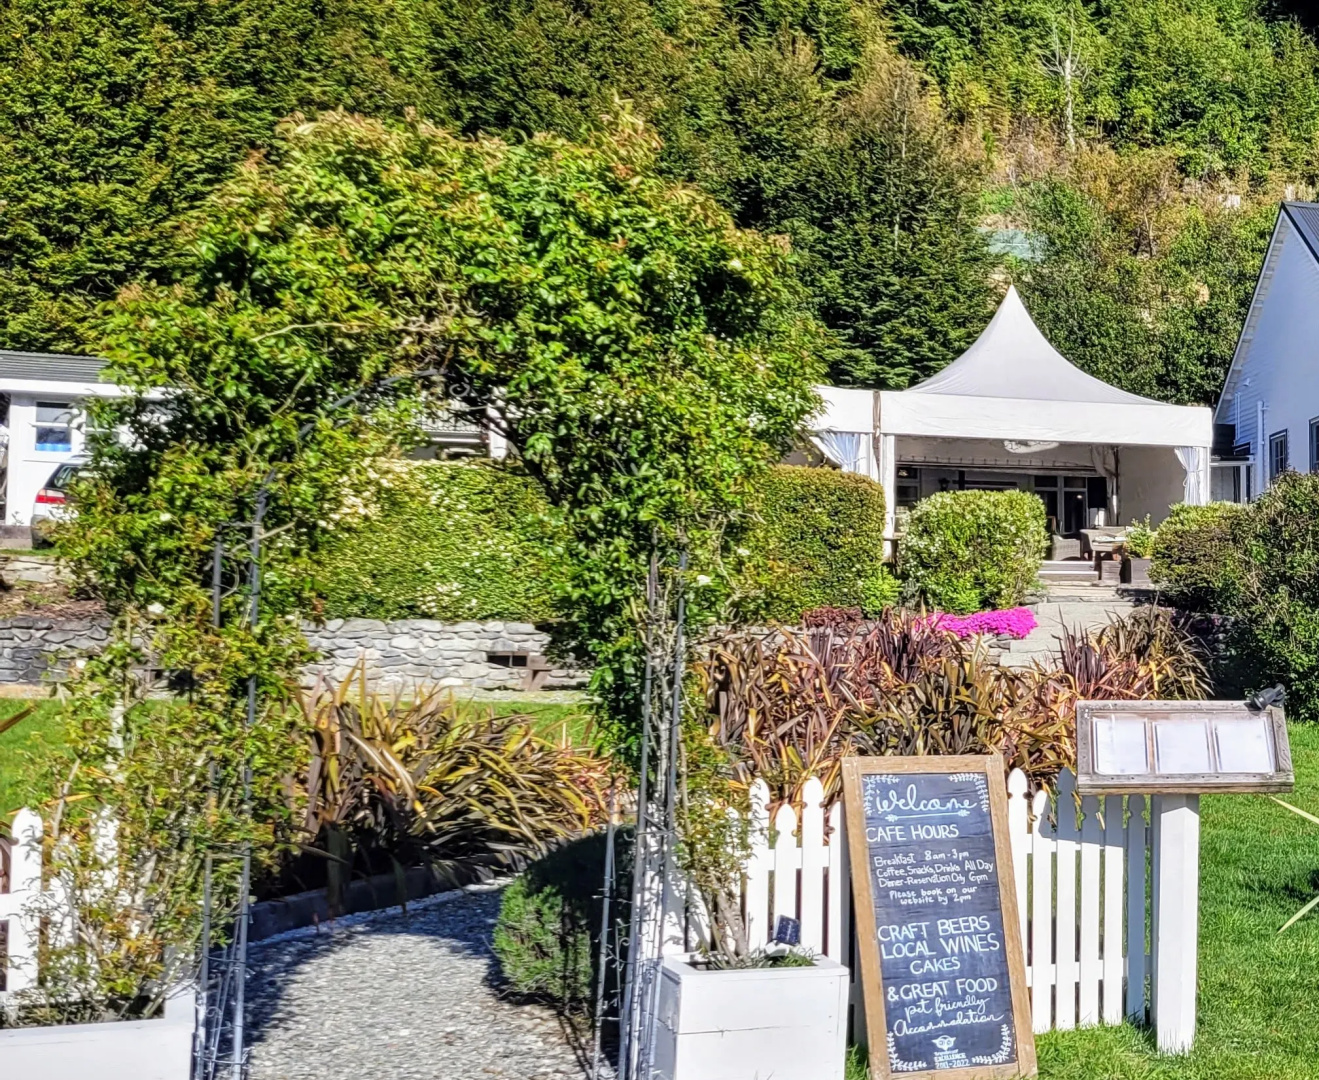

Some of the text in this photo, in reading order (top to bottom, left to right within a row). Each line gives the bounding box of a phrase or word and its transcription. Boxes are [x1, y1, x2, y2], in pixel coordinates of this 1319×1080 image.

[865, 824, 959, 842] CAFE HOURS
[874, 853, 916, 867] Breakfast
[964, 860, 976, 871] All
[976, 859, 994, 873] Day
[968, 872, 988, 884] 6pm
[900, 894, 972, 905] website by 2pm
[920, 888, 942, 896] book
[877, 915, 990, 942] CRAFT BEERS
[880, 933, 1000, 959] LOCAL WINES
[909, 956, 960, 974] CAKES
[956, 977, 998, 995] FOOD
[904, 995, 990, 1023] pet friendly
